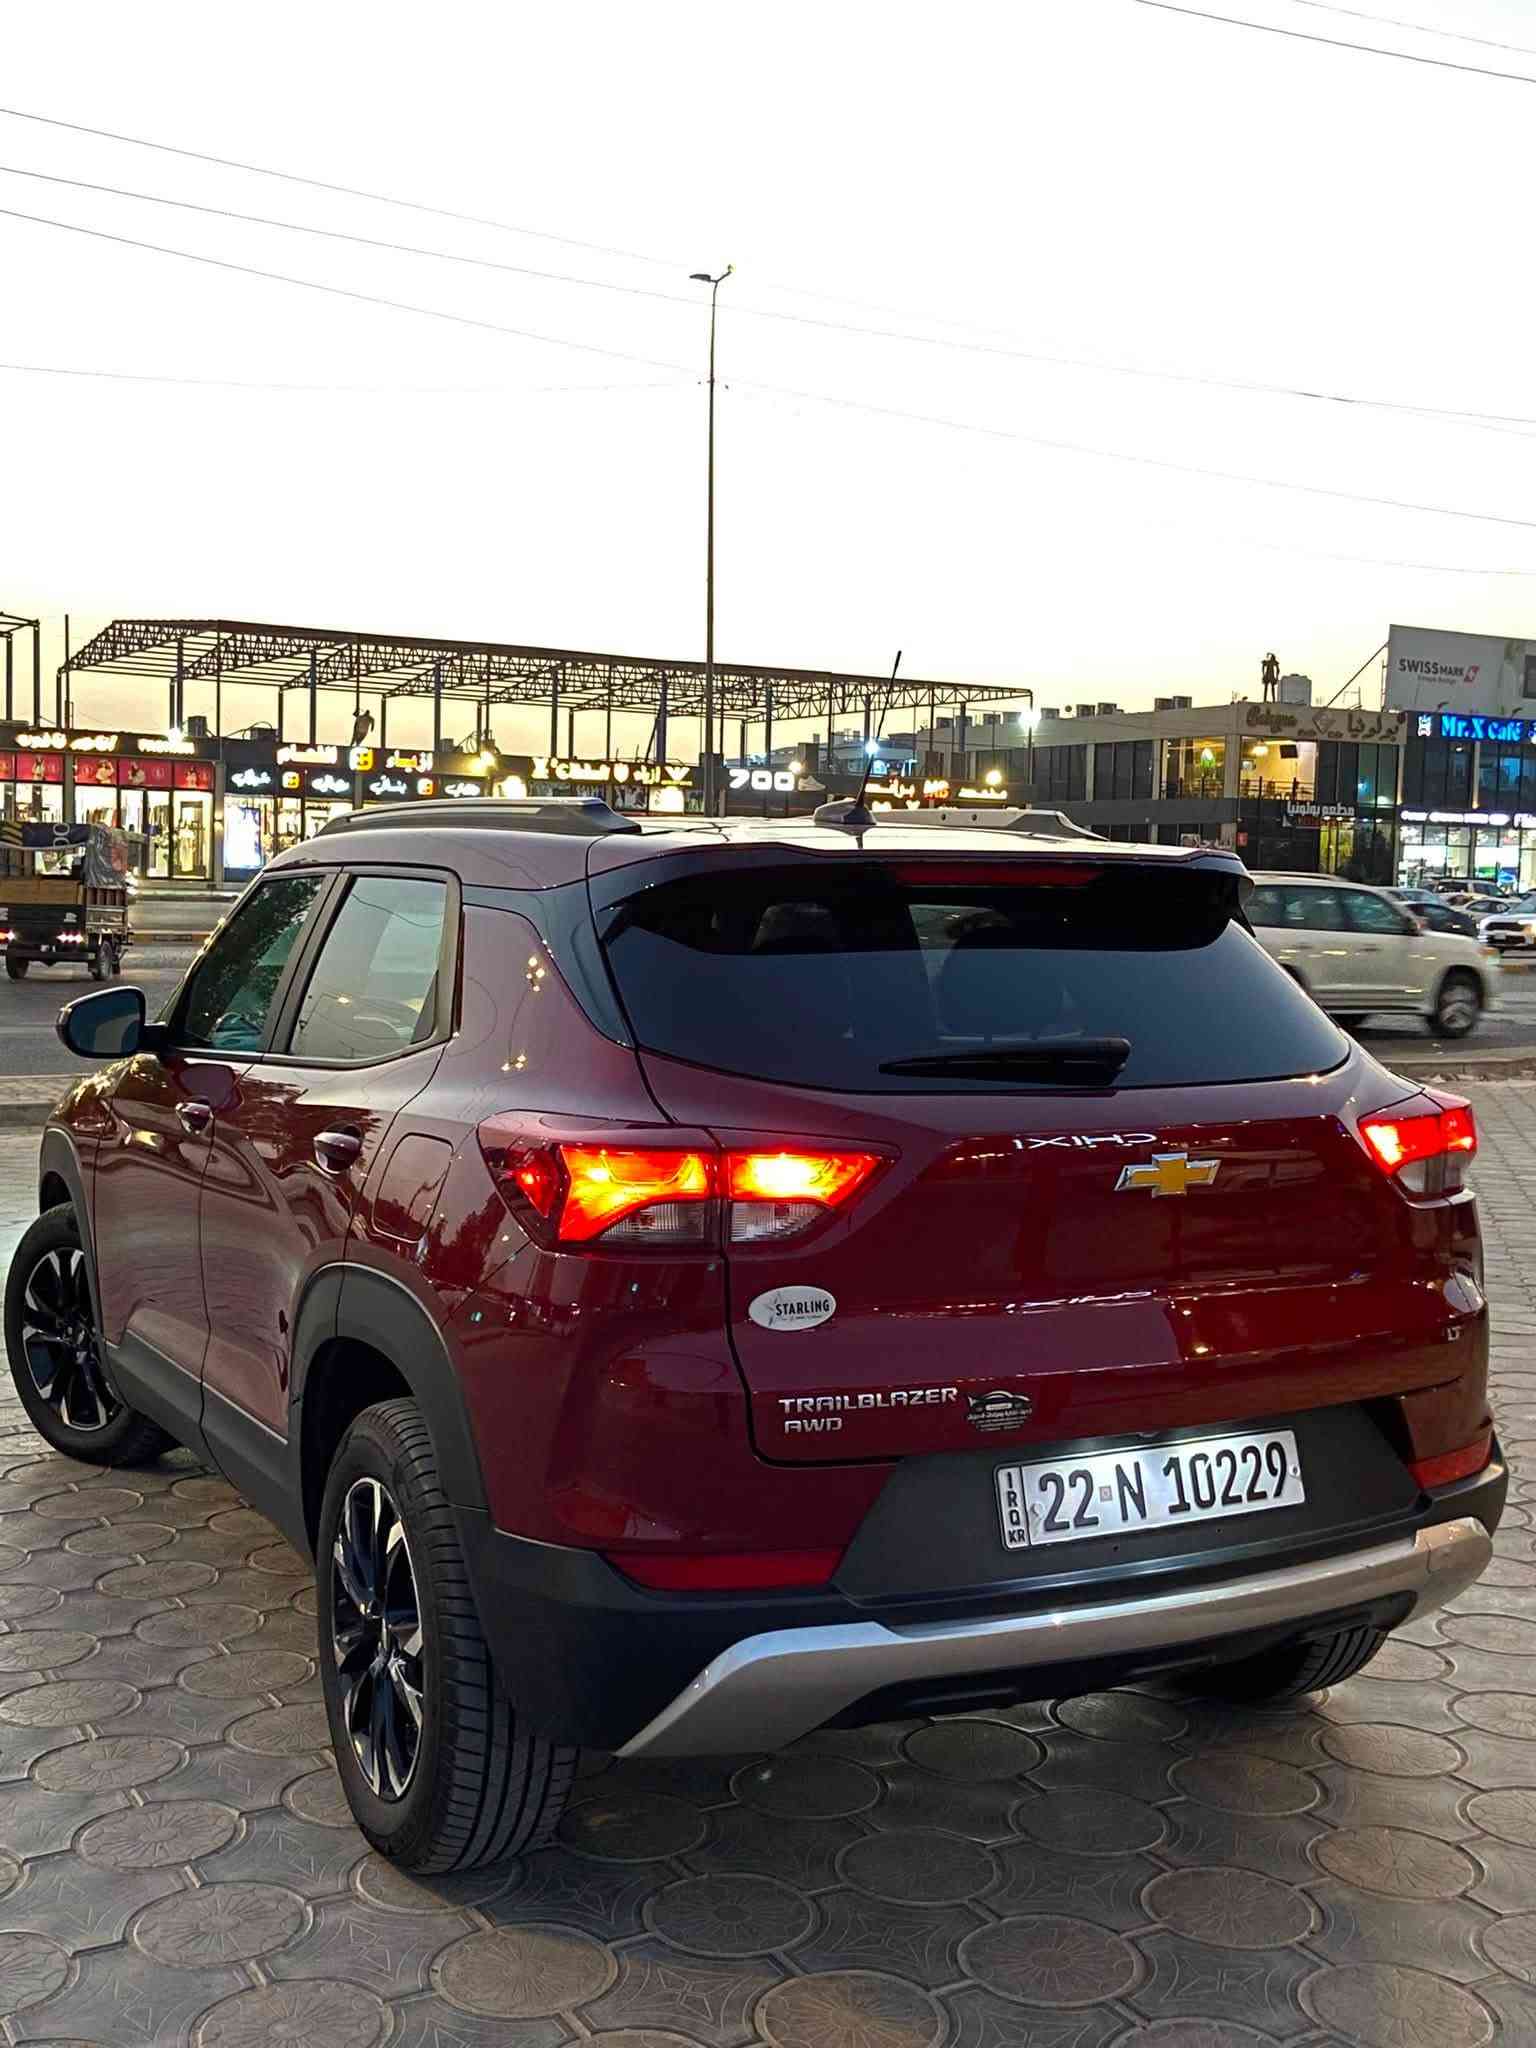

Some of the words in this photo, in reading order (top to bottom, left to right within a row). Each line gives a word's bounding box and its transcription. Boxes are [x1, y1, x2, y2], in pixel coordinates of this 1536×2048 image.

[729, 766, 795, 791] 700
[1321, 802, 1355, 817] مطعم
[775, 1299, 830, 1316] STARLING
[779, 1387, 958, 1414] TRAILBLAZER
[784, 1417, 842, 1434] AWD
[1038, 1468, 1099, 1532] 22
[1115, 1461, 1148, 1522] N
[1162, 1441, 1288, 1514] 10229
[1008, 1528, 1025, 1543] KR
